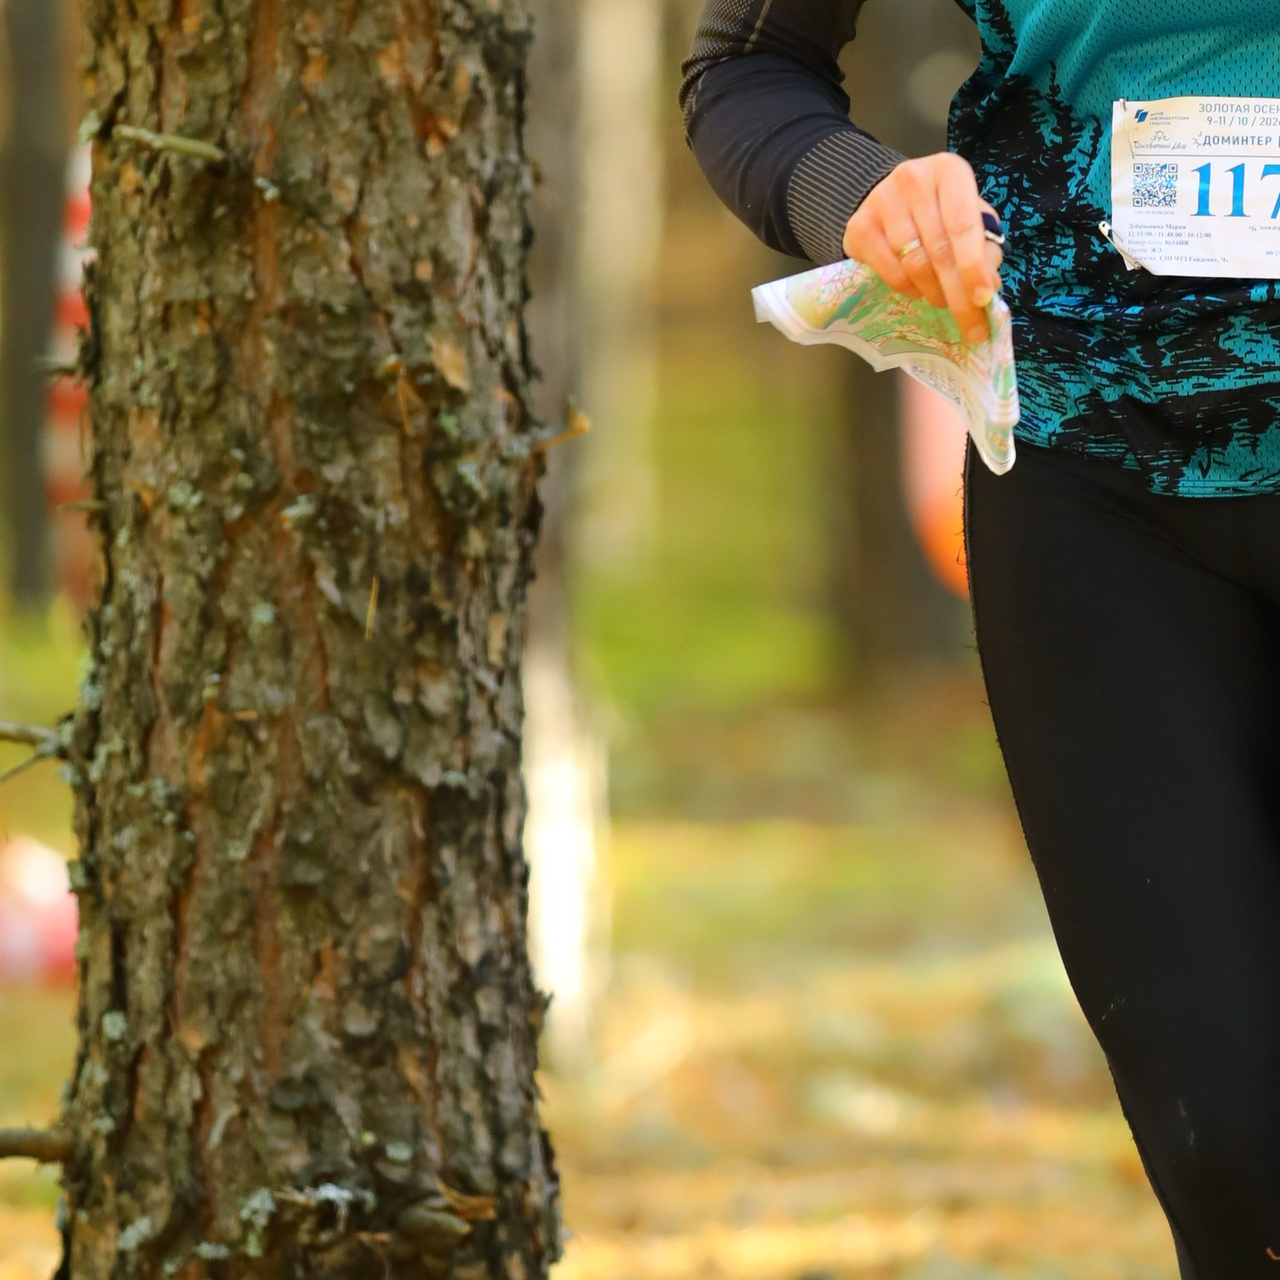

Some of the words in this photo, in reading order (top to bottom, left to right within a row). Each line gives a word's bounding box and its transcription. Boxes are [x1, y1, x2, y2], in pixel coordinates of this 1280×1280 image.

[1198, 103, 1250, 113] ЗОЛОТАЯ
[1206, 116, 1226, 125] 9-11
[1238, 116, 1248, 126] 10
[1202, 135, 1273, 147] ДОМИНТЕР
